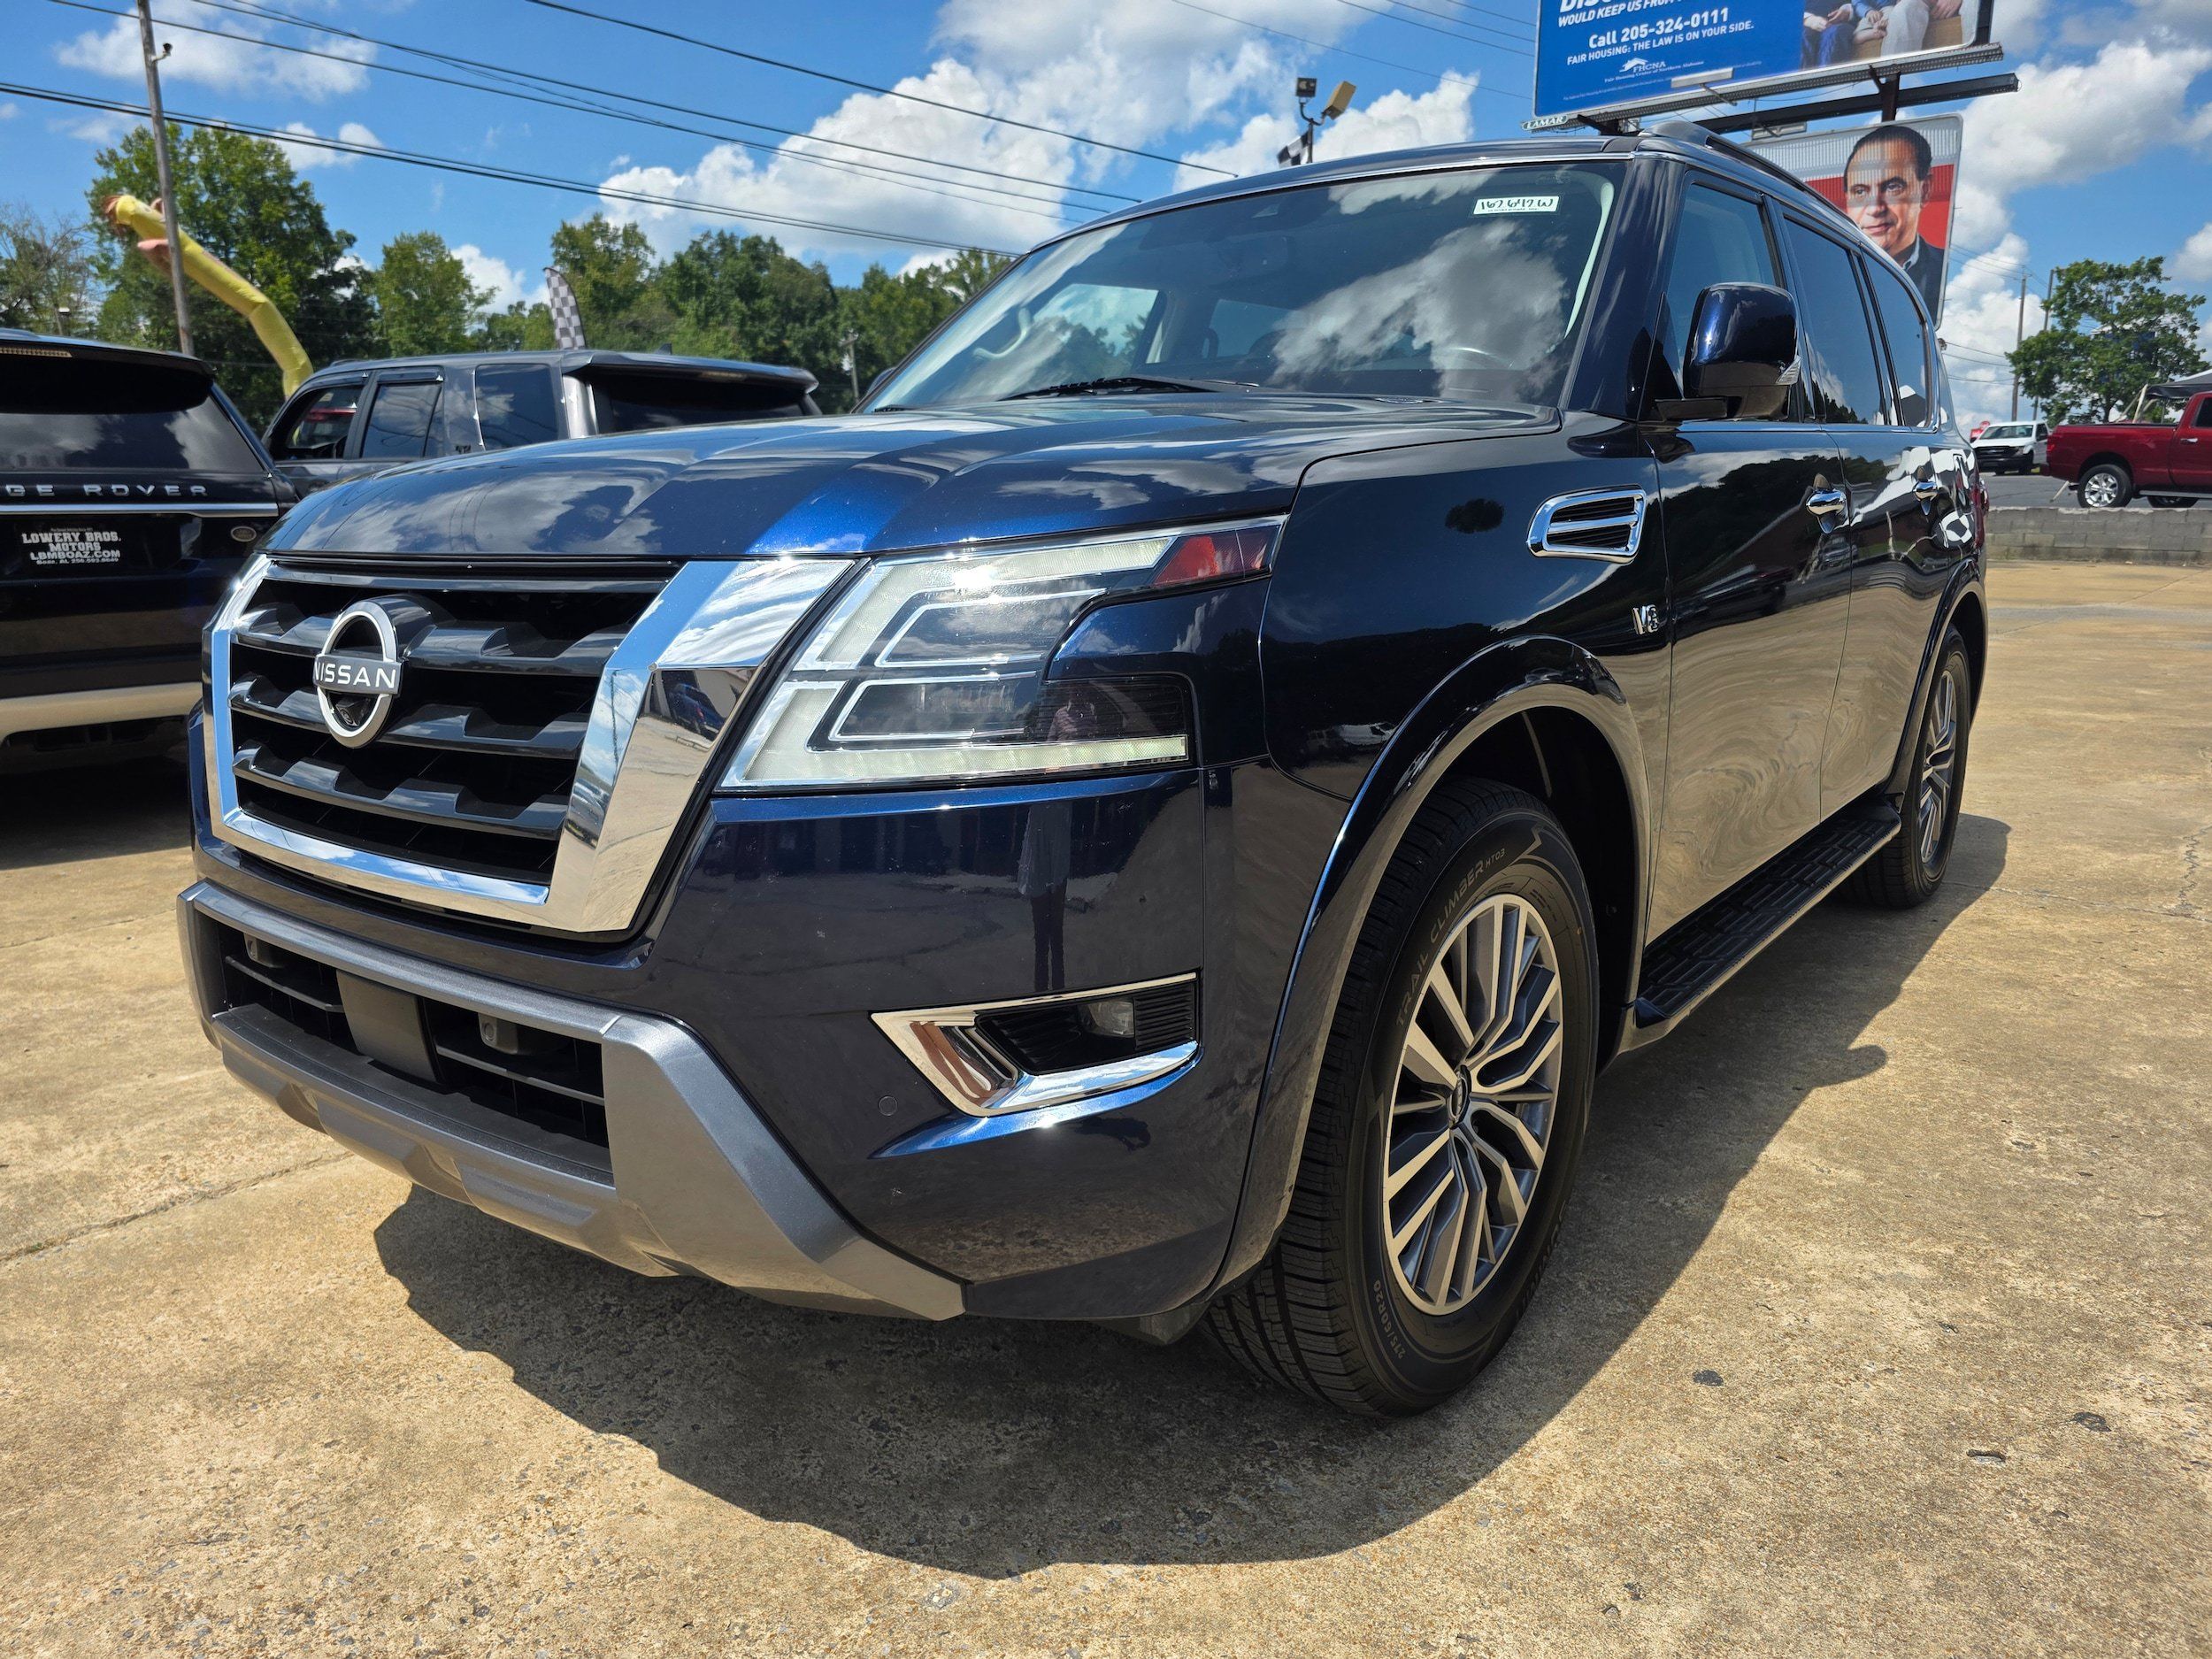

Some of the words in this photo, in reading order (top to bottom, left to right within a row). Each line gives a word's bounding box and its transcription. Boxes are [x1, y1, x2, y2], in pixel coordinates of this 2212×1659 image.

[1558, 10, 1595, 27] WOULD
[1596, 3, 1626, 19] KEEP
[1626, 0, 1644, 12] US
[1588, 30, 1617, 49] Call
[1621, 7, 1729, 42] 205-324-0111
[1567, 53, 1586, 65] FAIR
[1588, 45, 1631, 61] HOUSING:
[1632, 41, 1651, 52] THE
[1653, 35, 1673, 48] LAW
[1675, 34, 1684, 43] IS
[1686, 30, 1700, 41] ON
[1701, 26, 1727, 38] YOUR
[1729, 20, 1755, 34] SIDE.
[1632, 61, 1666, 73] FHCNA
[1526, 116, 1564, 129] LAMAR
[83, 484, 208, 496] ROVER
[22, 532, 80, 543] LOWERY
[85, 532, 121, 541] BROS.
[49, 542, 101, 552] MOTORS
[29, 549, 121, 561] LBMBOAZ.COM
[1632, 604, 1659, 635] V8
[314, 661, 396, 689] NISSAN
[1396, 951, 1429, 1026] TRAIL
[1430, 859, 1485, 944] CLIMBER
